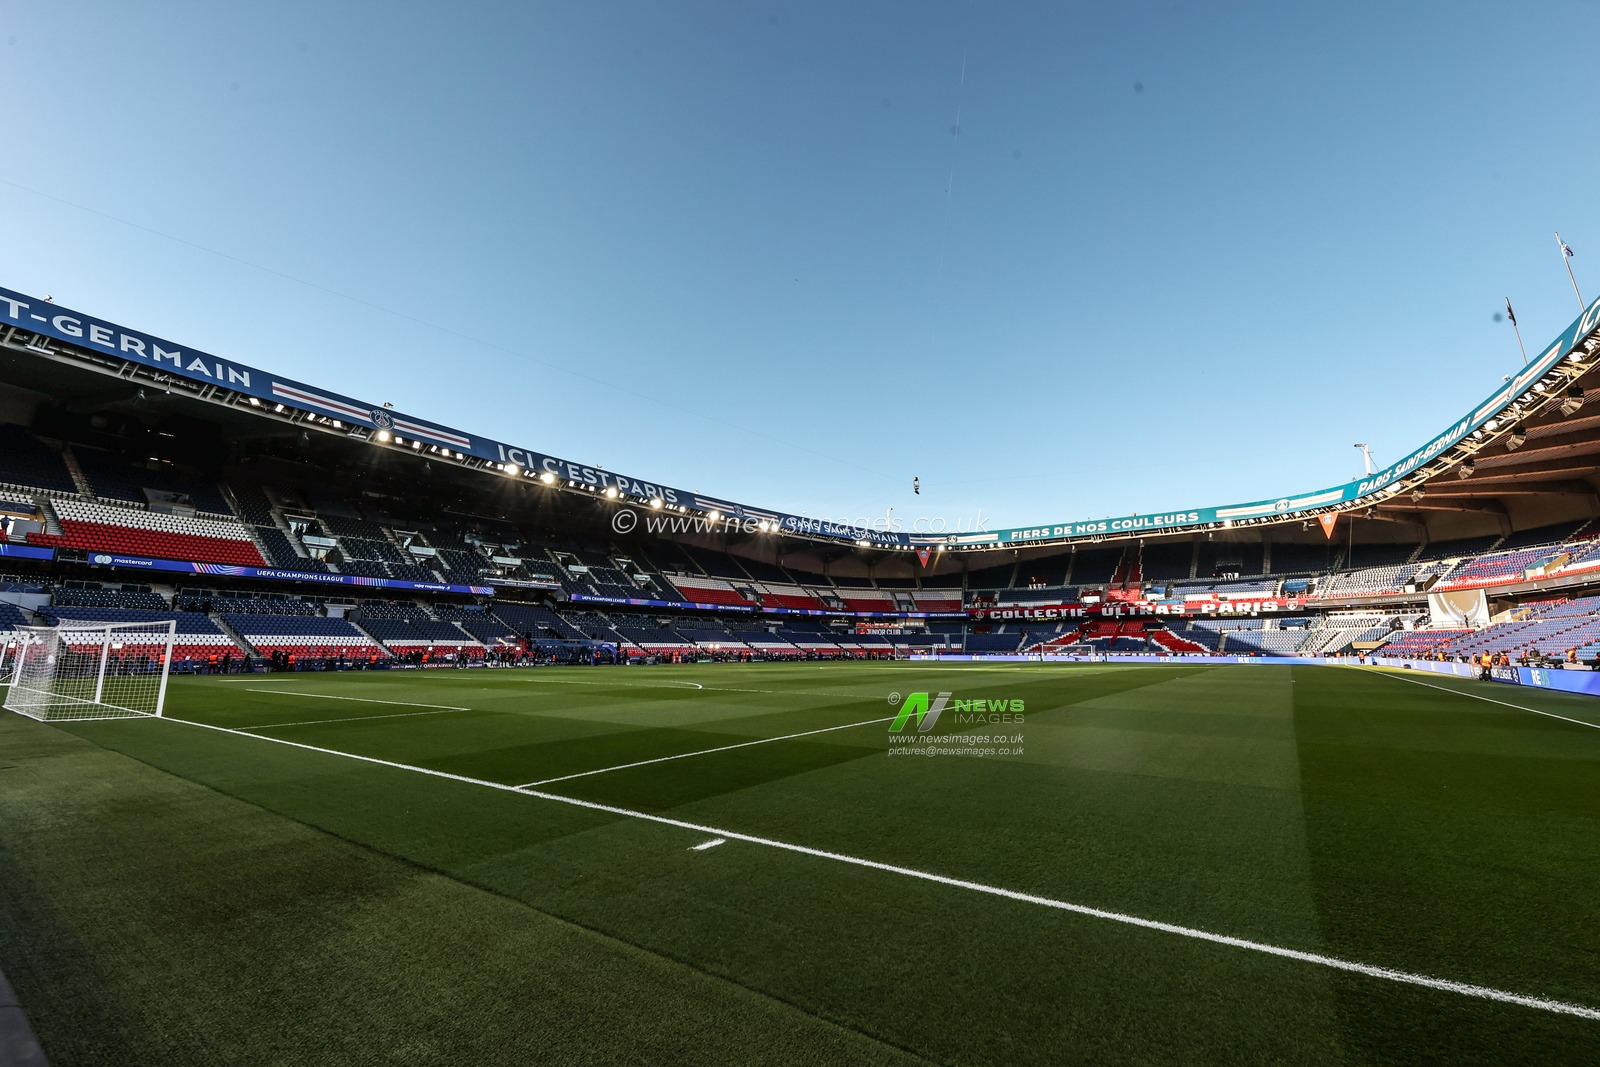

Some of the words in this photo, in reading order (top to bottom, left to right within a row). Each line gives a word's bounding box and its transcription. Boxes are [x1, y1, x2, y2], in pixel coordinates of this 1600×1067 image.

[1356, 470, 1393, 495] PARIS
[1393, 417, 1471, 479] SAINT-GERMAIN
[498, 444, 534, 469] ICI
[542, 458, 609, 487] C'EST
[615, 476, 678, 503] PARIS
[791, 519, 820, 531] PARIS
[824, 523, 899, 542] SAINT-GERMAIN
[1011, 527, 1050, 540] FIERS
[1056, 525, 1073, 536] DE
[1076, 522, 1107, 534] NOS
[1111, 512, 1199, 530] COULEURS
[114, 557, 153, 568] mastercard
[257, 569, 275, 577] UEFA
[276, 571, 318, 581] CHAMPIONS
[990, 607, 1088, 619] COLLECTIF
[1101, 603, 1186, 617] ULTRAS
[1201, 601, 1279, 614] PARIS
[1531, 669, 1551, 686] REUS
